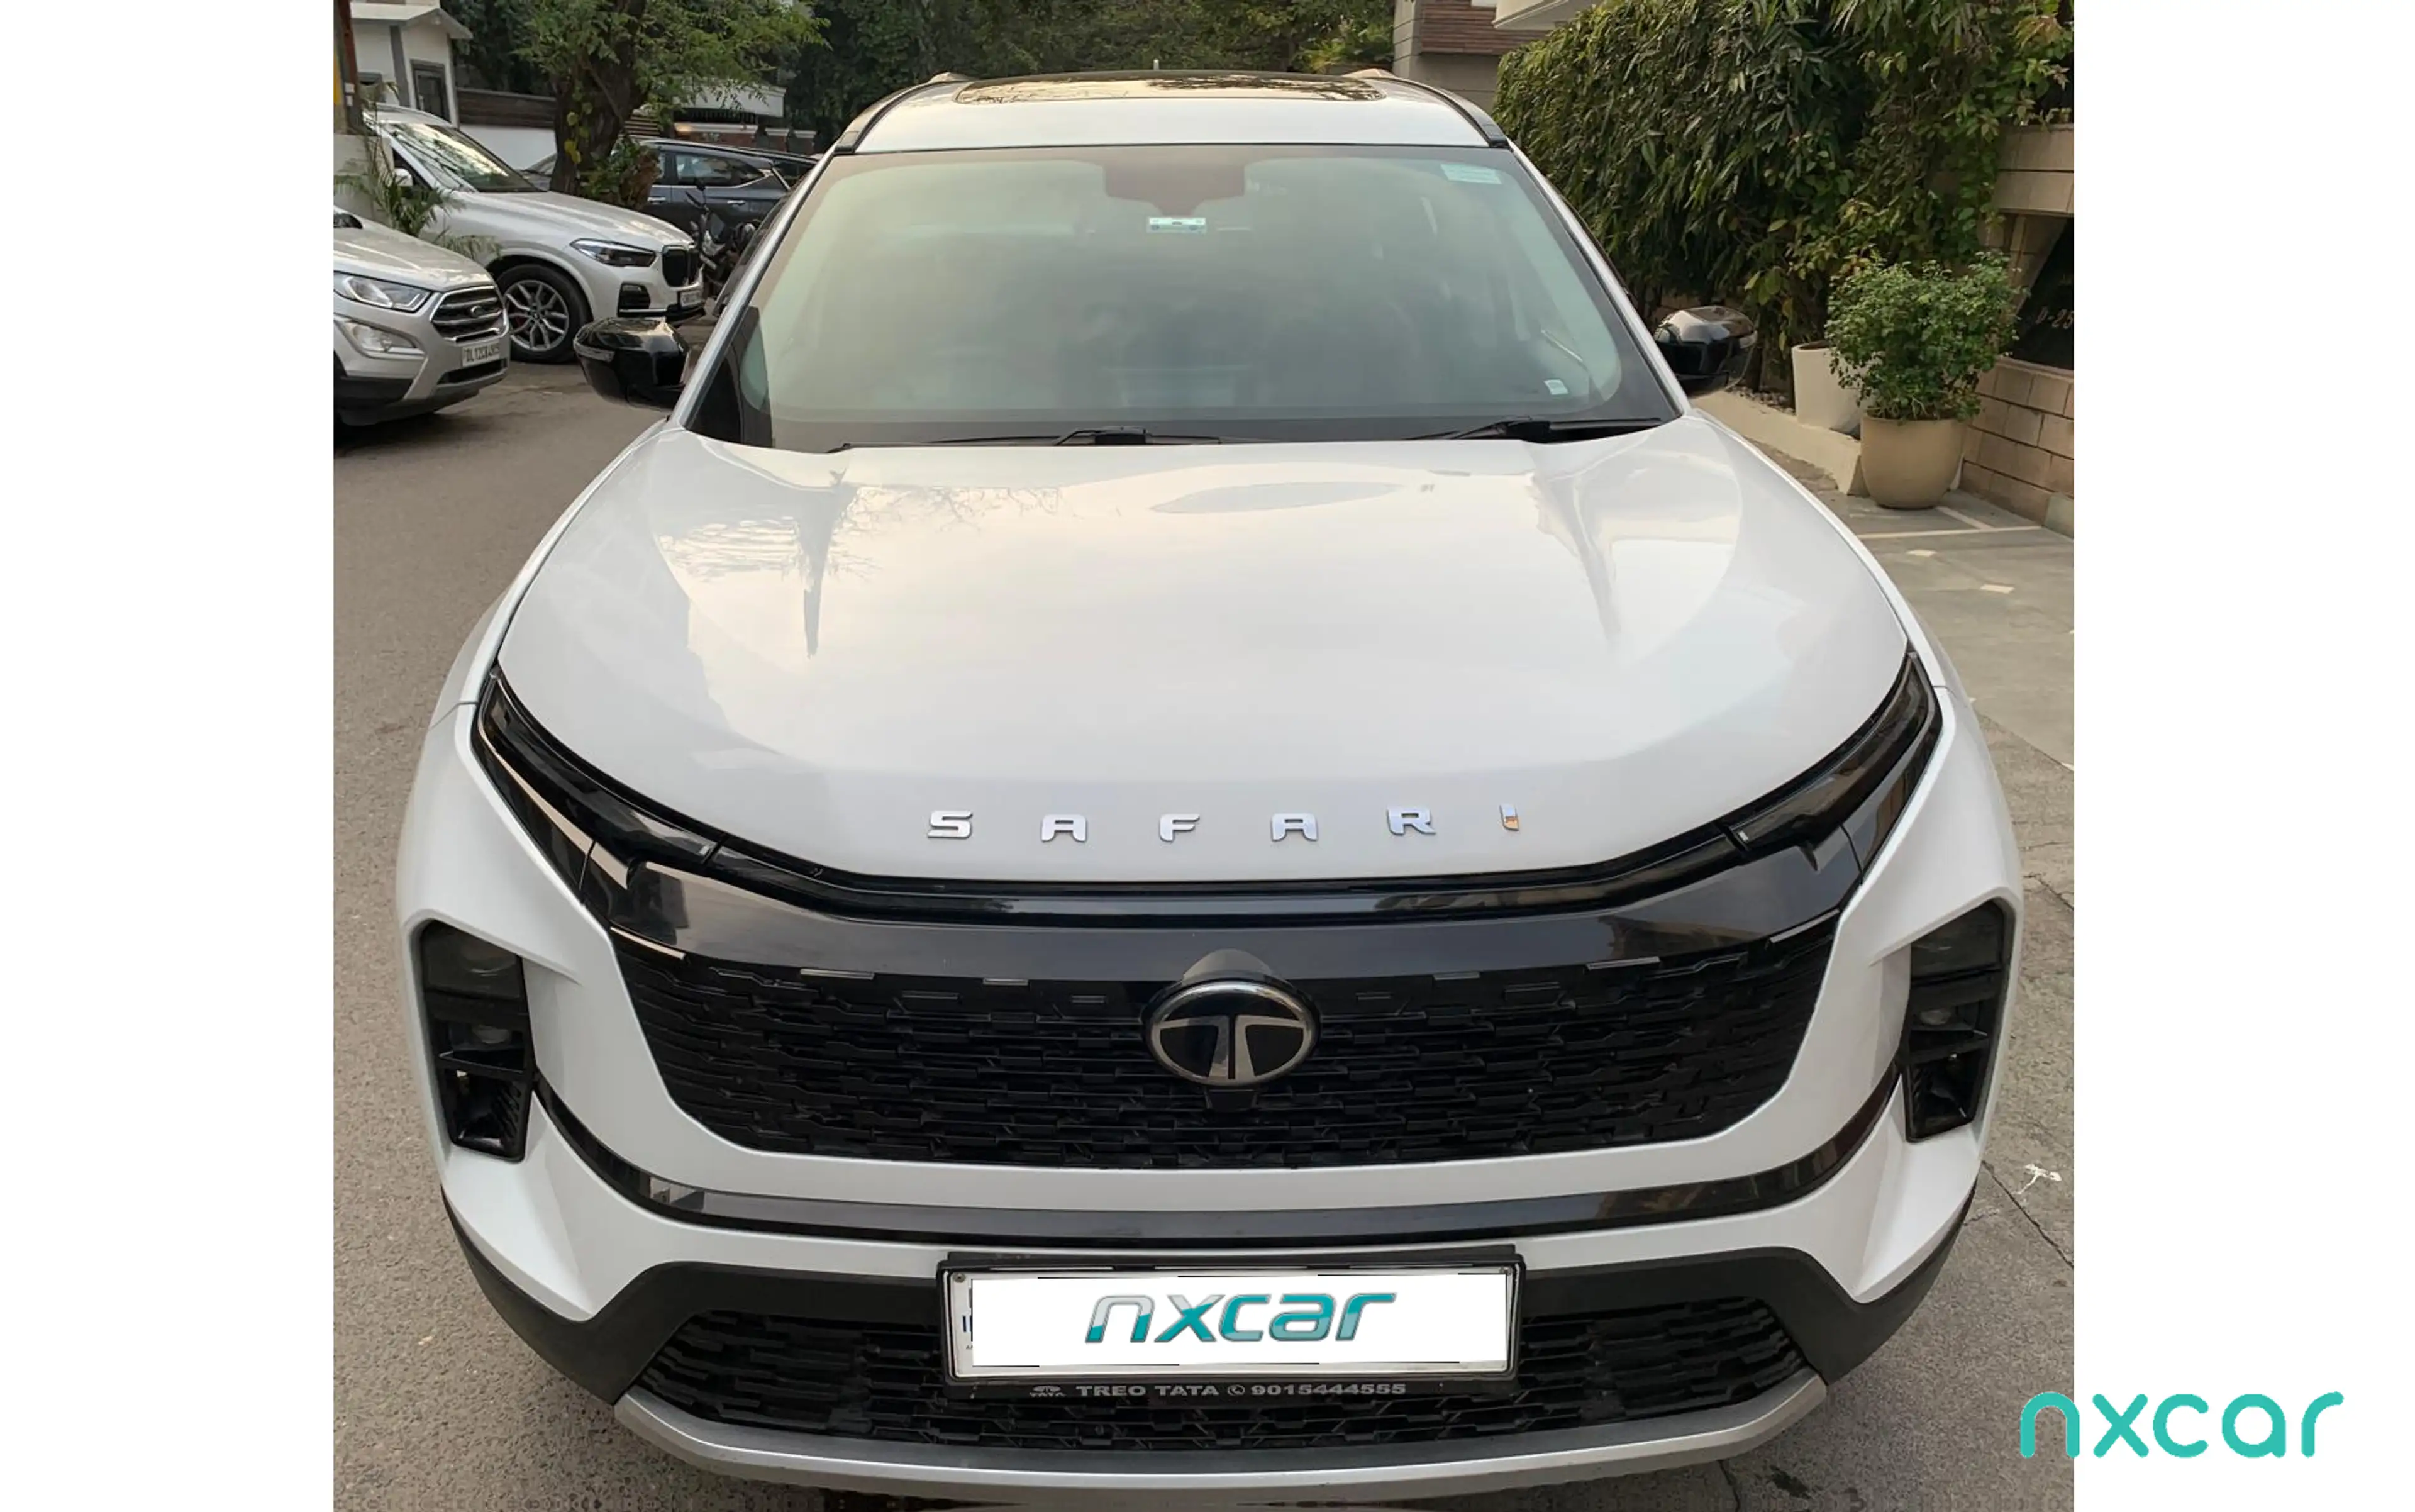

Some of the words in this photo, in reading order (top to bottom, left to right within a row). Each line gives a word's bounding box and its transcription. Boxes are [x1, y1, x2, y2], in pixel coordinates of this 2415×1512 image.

[927, 804, 1521, 842] SAFARI
[1076, 1385, 1146, 1397] TREO
[1155, 1385, 1219, 1396] TATA
[1251, 1384, 1406, 1396] 9015444555
